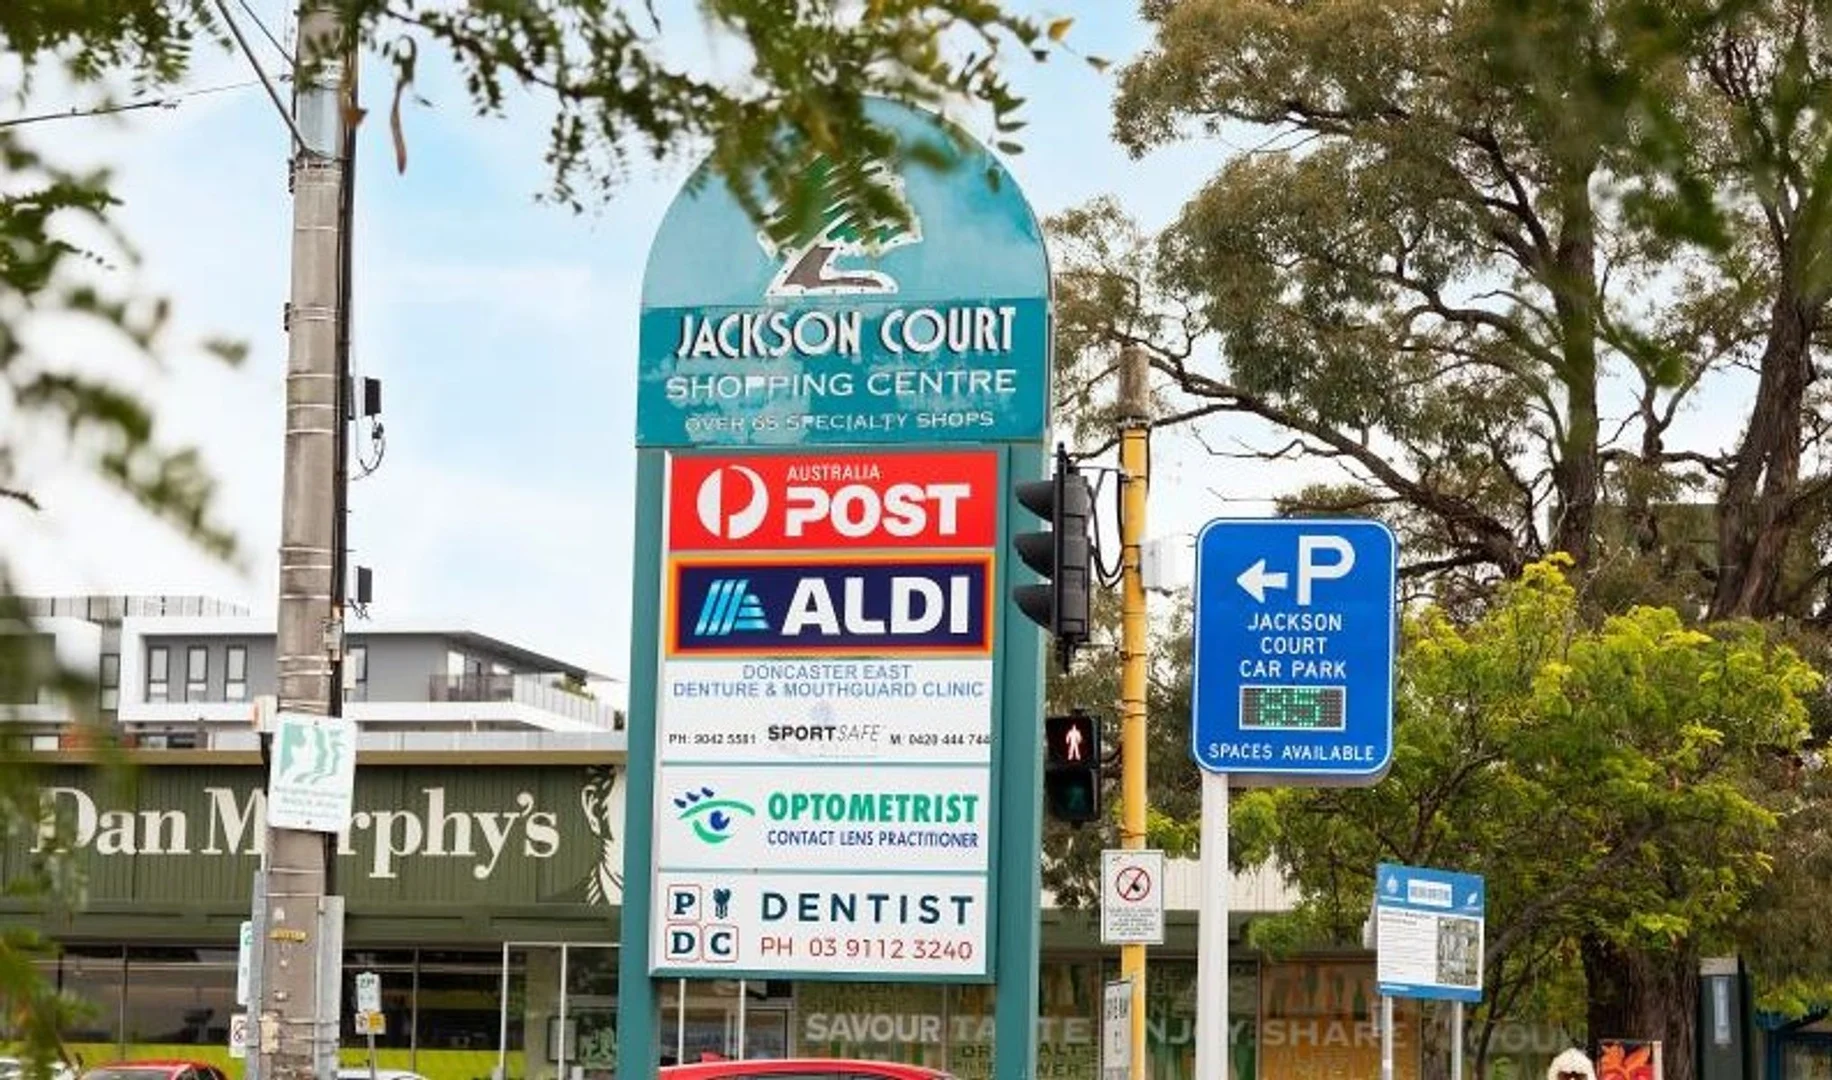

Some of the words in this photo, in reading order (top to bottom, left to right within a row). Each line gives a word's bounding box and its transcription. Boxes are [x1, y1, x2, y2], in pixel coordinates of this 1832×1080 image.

[677, 310, 861, 358] JACKSON
[880, 306, 1016, 354] COURT
[665, 371, 854, 400] SHOPPING
[866, 369, 1017, 397] CENTRE
[685, 415, 745, 431] OVER
[751, 414, 779, 431] 65
[785, 412, 909, 431] SPECIALTY
[916, 411, 994, 428] SHOPS
[786, 464, 881, 481] AUSTRALIA
[785, 483, 971, 538] POST
[1296, 535, 1355, 606] P
[780, 575, 970, 636] ALDI
[1247, 613, 1342, 631] JACKSON
[1260, 636, 1327, 654] COURT
[742, 664, 858, 680] DONCASTER
[863, 664, 913, 680] EAST
[1239, 660, 1281, 678] CAR
[1291, 660, 1346, 679] PARK
[673, 682, 759, 697] DENTURE
[765, 682, 777, 697] &
[784, 681, 918, 697] MOUTHGUARD
[922, 681, 984, 697] CLINIC
[1260, 688, 1321, 727] 85
[668, 733, 691, 745] PH:
[1208, 743, 1272, 760] SPACES
[1282, 745, 1374, 761] AVAILABLE
[768, 792, 979, 823] OPTOMETRIST
[30, 786, 191, 855] Dan
[201, 786, 560, 879] Mrphy's
[767, 830, 835, 846] CONTACT
[839, 830, 874, 846] LENS
[878, 831, 979, 848] PRACTITIONER
[673, 892, 696, 915] P
[761, 893, 974, 925] DENTIST
[672, 931, 696, 954] D
[710, 932, 731, 955] C
[761, 937, 793, 956] PH
[809, 938, 837, 957] 03
[846, 939, 904, 959] 9112
[913, 940, 973, 960] 3240
[805, 1013, 941, 1042] SAVOUR
[949, 1015, 1090, 1043] TATE
